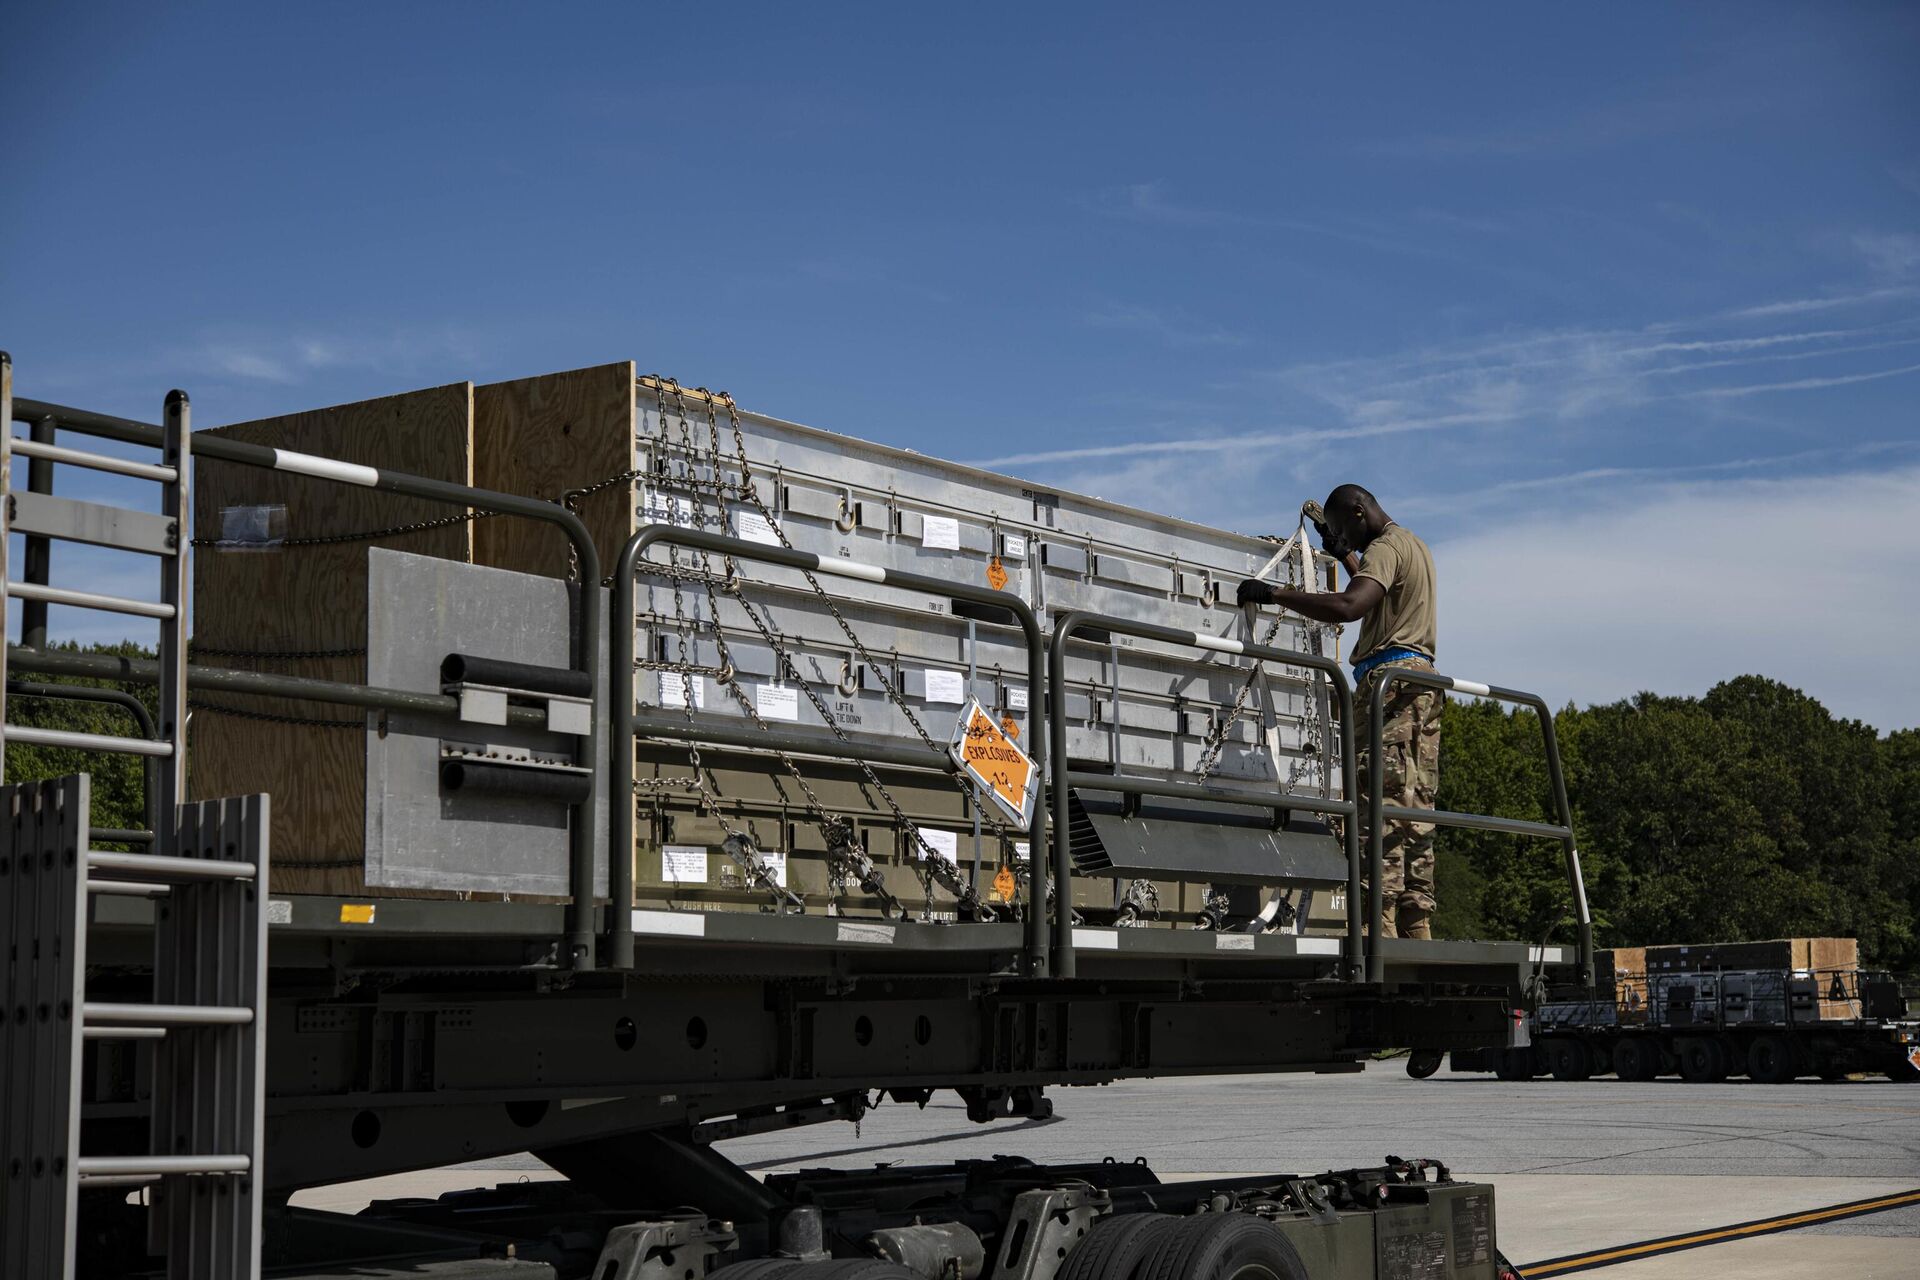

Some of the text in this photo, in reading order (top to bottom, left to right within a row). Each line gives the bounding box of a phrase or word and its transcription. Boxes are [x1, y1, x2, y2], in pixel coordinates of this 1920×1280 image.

[835, 701, 849, 712] LIFT
[836, 712, 862, 725] TIE DOWN
[966, 746, 1021, 764] EXPLOSIVES
[993, 771, 1009, 786] 1.2
[682, 900, 721, 912] PUSH HERE
[1331, 895, 1345, 910] AFT
[939, 912, 953, 921] LIFT
[1136, 919, 1149, 928] LIFT
